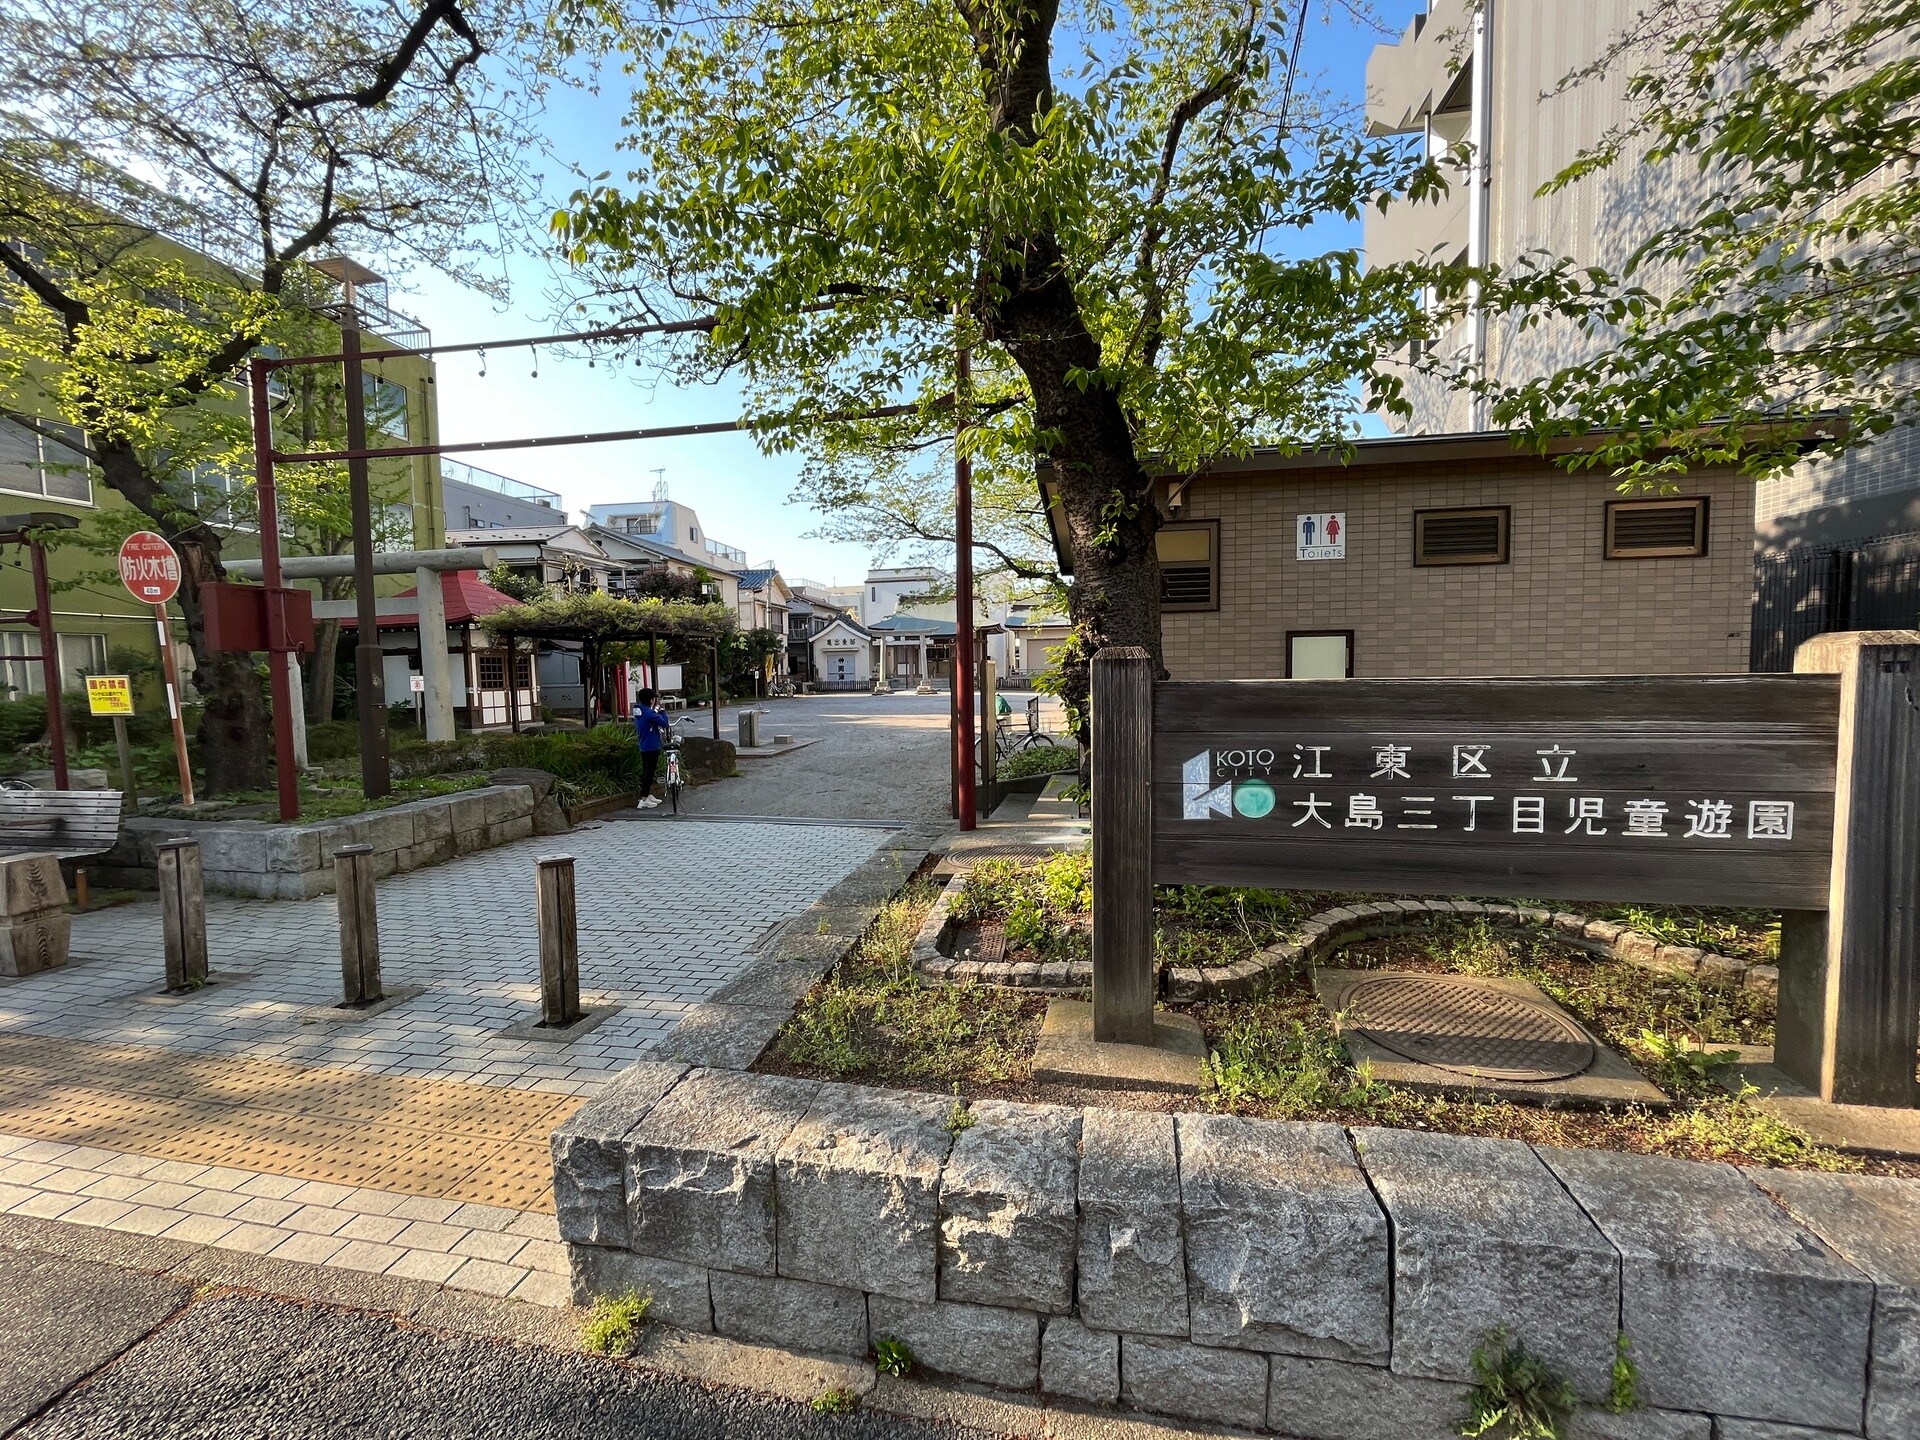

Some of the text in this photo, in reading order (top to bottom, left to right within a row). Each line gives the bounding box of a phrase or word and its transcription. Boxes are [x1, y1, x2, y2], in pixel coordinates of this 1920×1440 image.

[1300, 549, 1343, 558] Toilets
[1216, 749, 1275, 766] KOTO
[1292, 744, 1578, 782] 江東区立
[1216, 767, 1272, 777] CITY
[1292, 793, 1795, 840] 大島三丁目児童遊園
